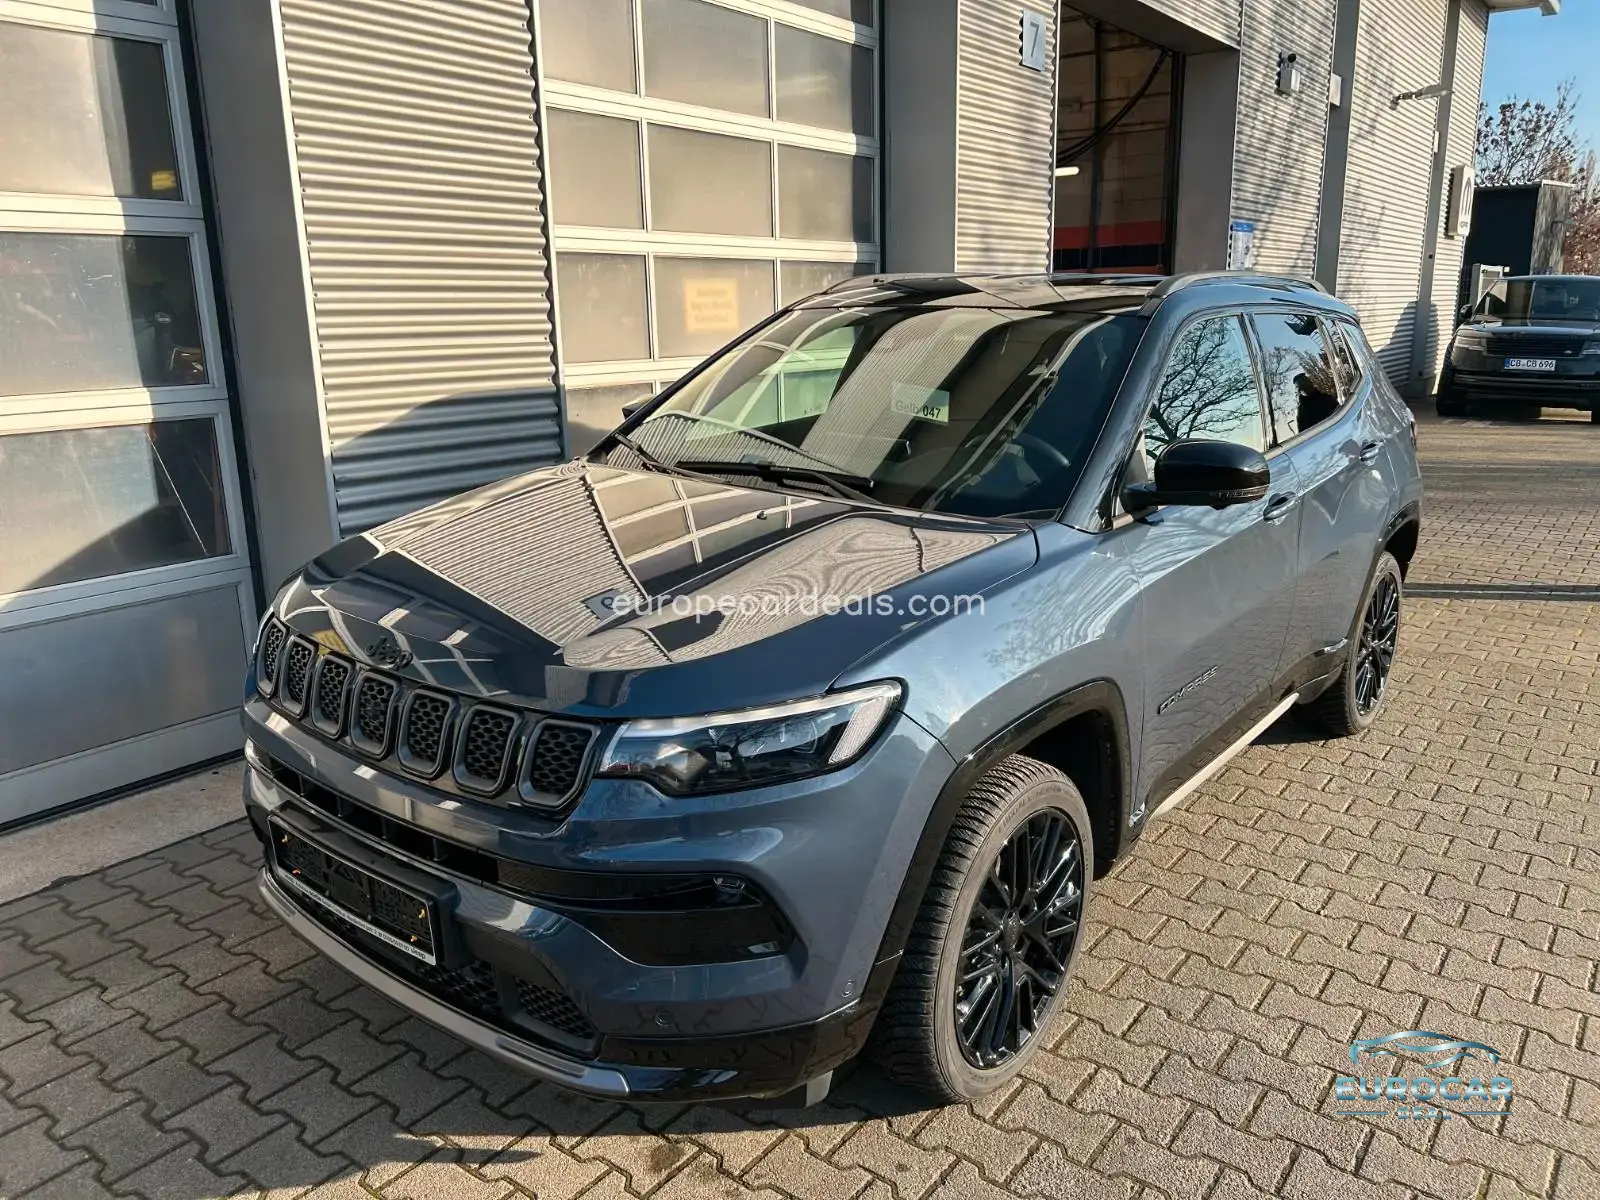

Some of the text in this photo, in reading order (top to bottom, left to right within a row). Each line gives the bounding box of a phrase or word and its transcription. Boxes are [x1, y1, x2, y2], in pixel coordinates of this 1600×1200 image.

[1030, 21, 1040, 58] 7
[1510, 359, 1554, 369] CB CB 696
[922, 405, 941, 418] 047
